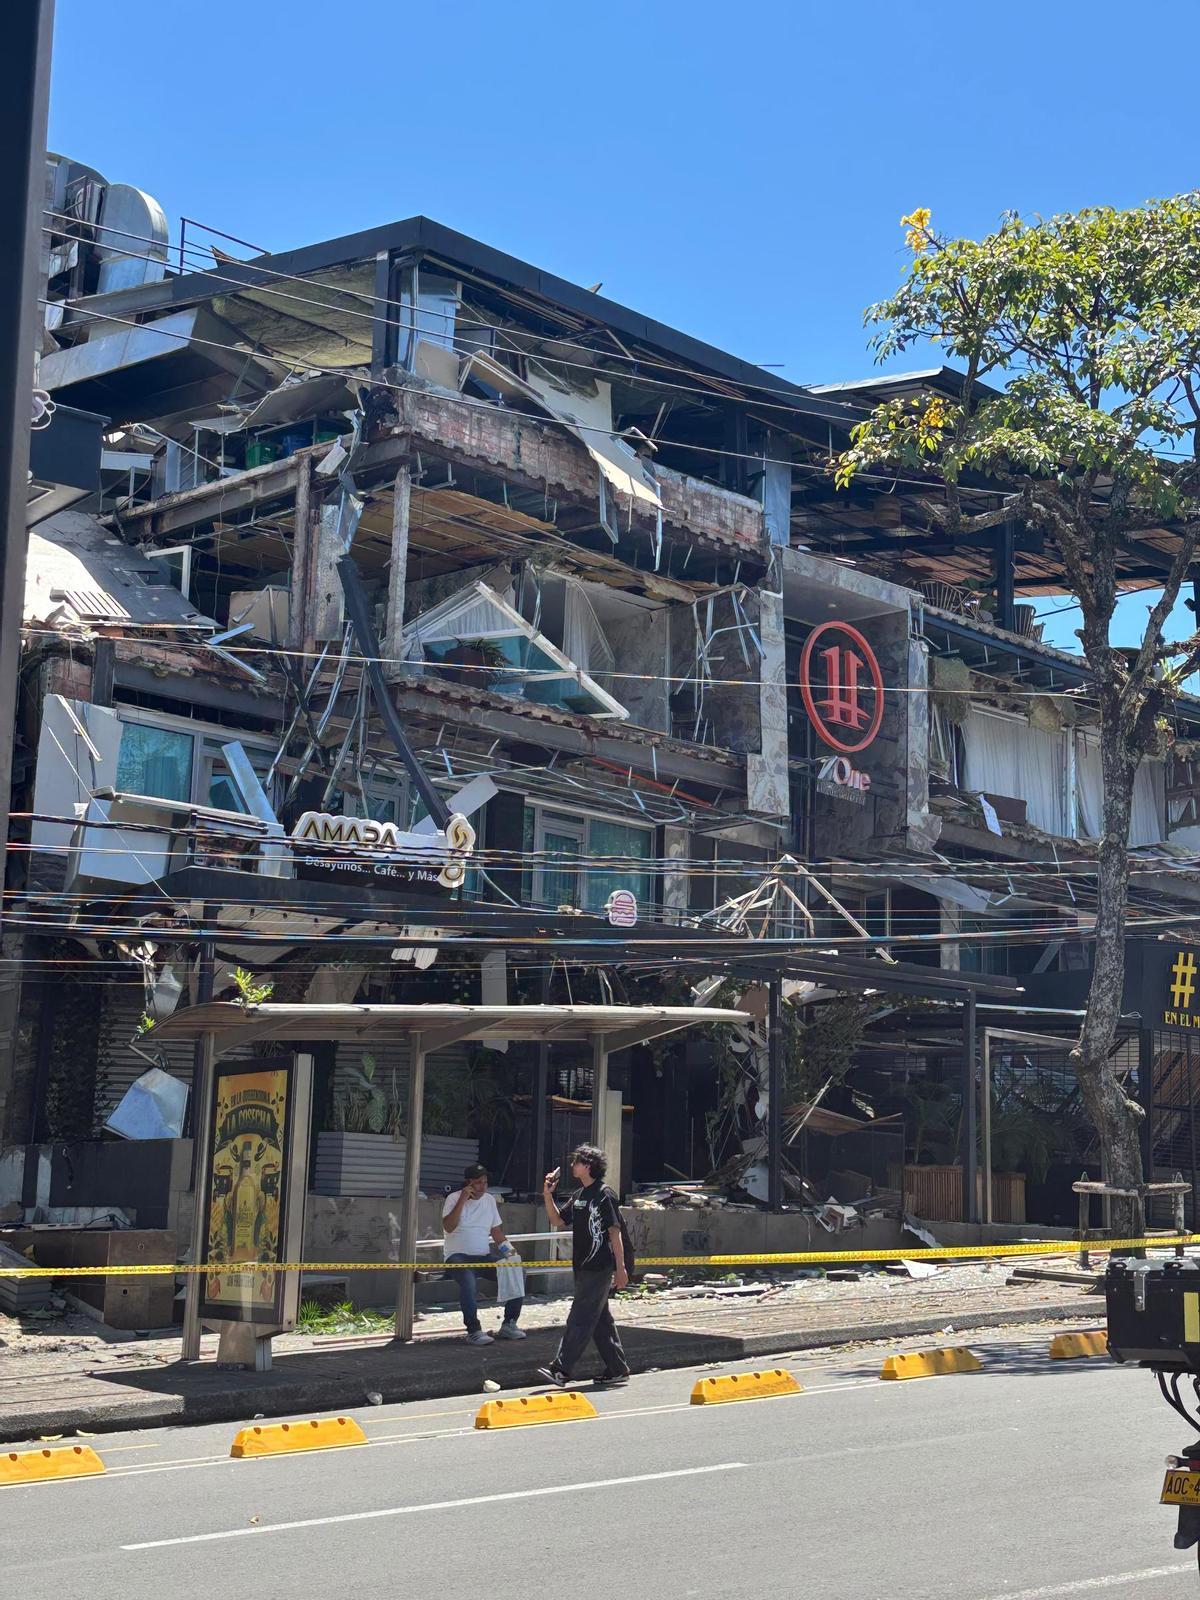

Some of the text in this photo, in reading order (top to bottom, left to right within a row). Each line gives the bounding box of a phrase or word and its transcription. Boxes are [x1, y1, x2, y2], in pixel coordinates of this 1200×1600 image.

[407, 870, 415, 882] y
[417, 870, 438, 882] Más
[1164, 1011, 1178, 1025] EN
[1180, 1013, 1192, 1027] EL
